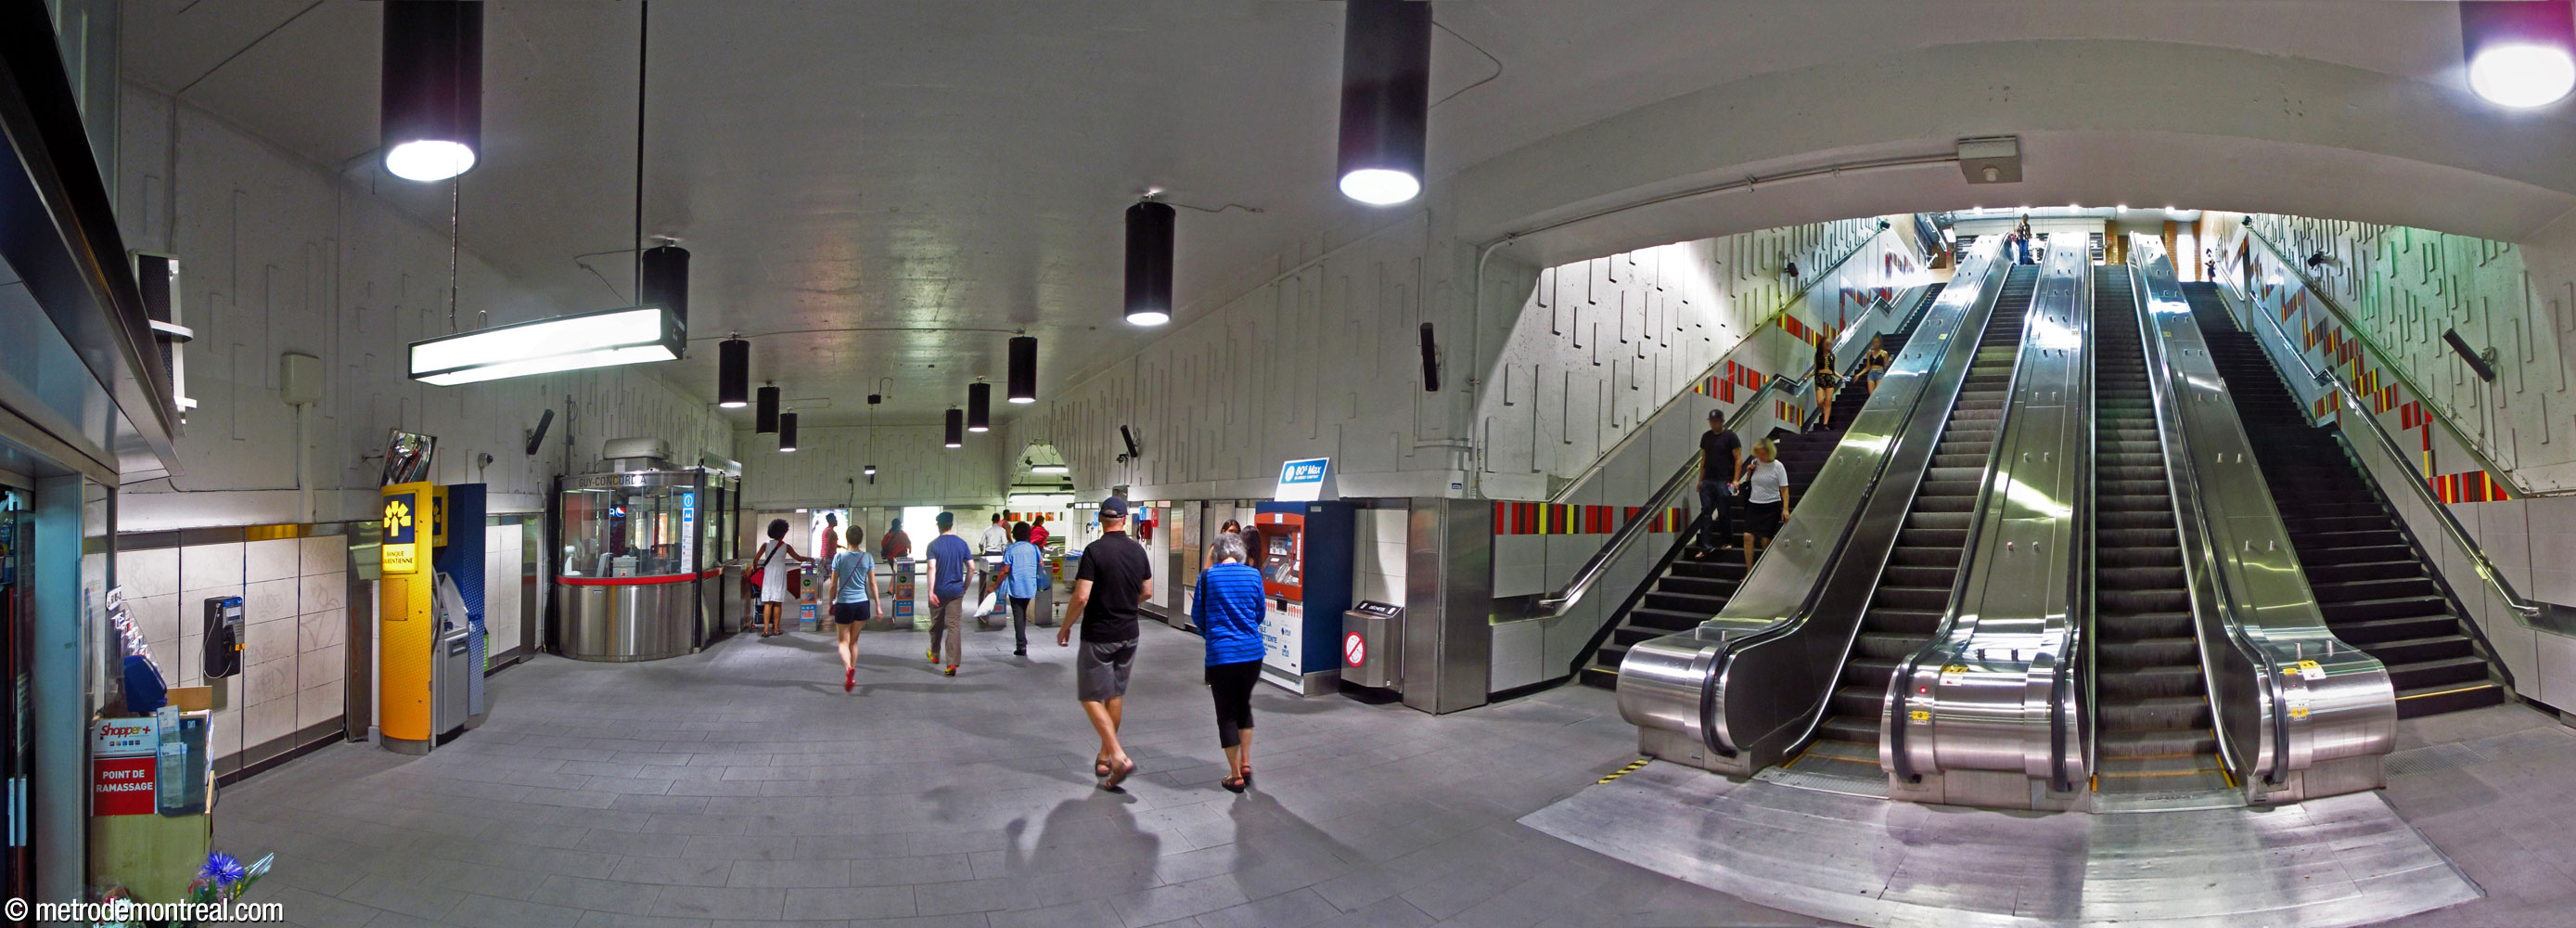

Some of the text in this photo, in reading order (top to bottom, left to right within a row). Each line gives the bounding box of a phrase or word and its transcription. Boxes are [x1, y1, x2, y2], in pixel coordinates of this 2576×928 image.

[1308, 465, 1321, 474] Max
[579, 475, 647, 487] GUY-CONCORDA
[103, 769, 145, 780] POINT DE
[96, 782, 153, 793] RAMASSAGE
